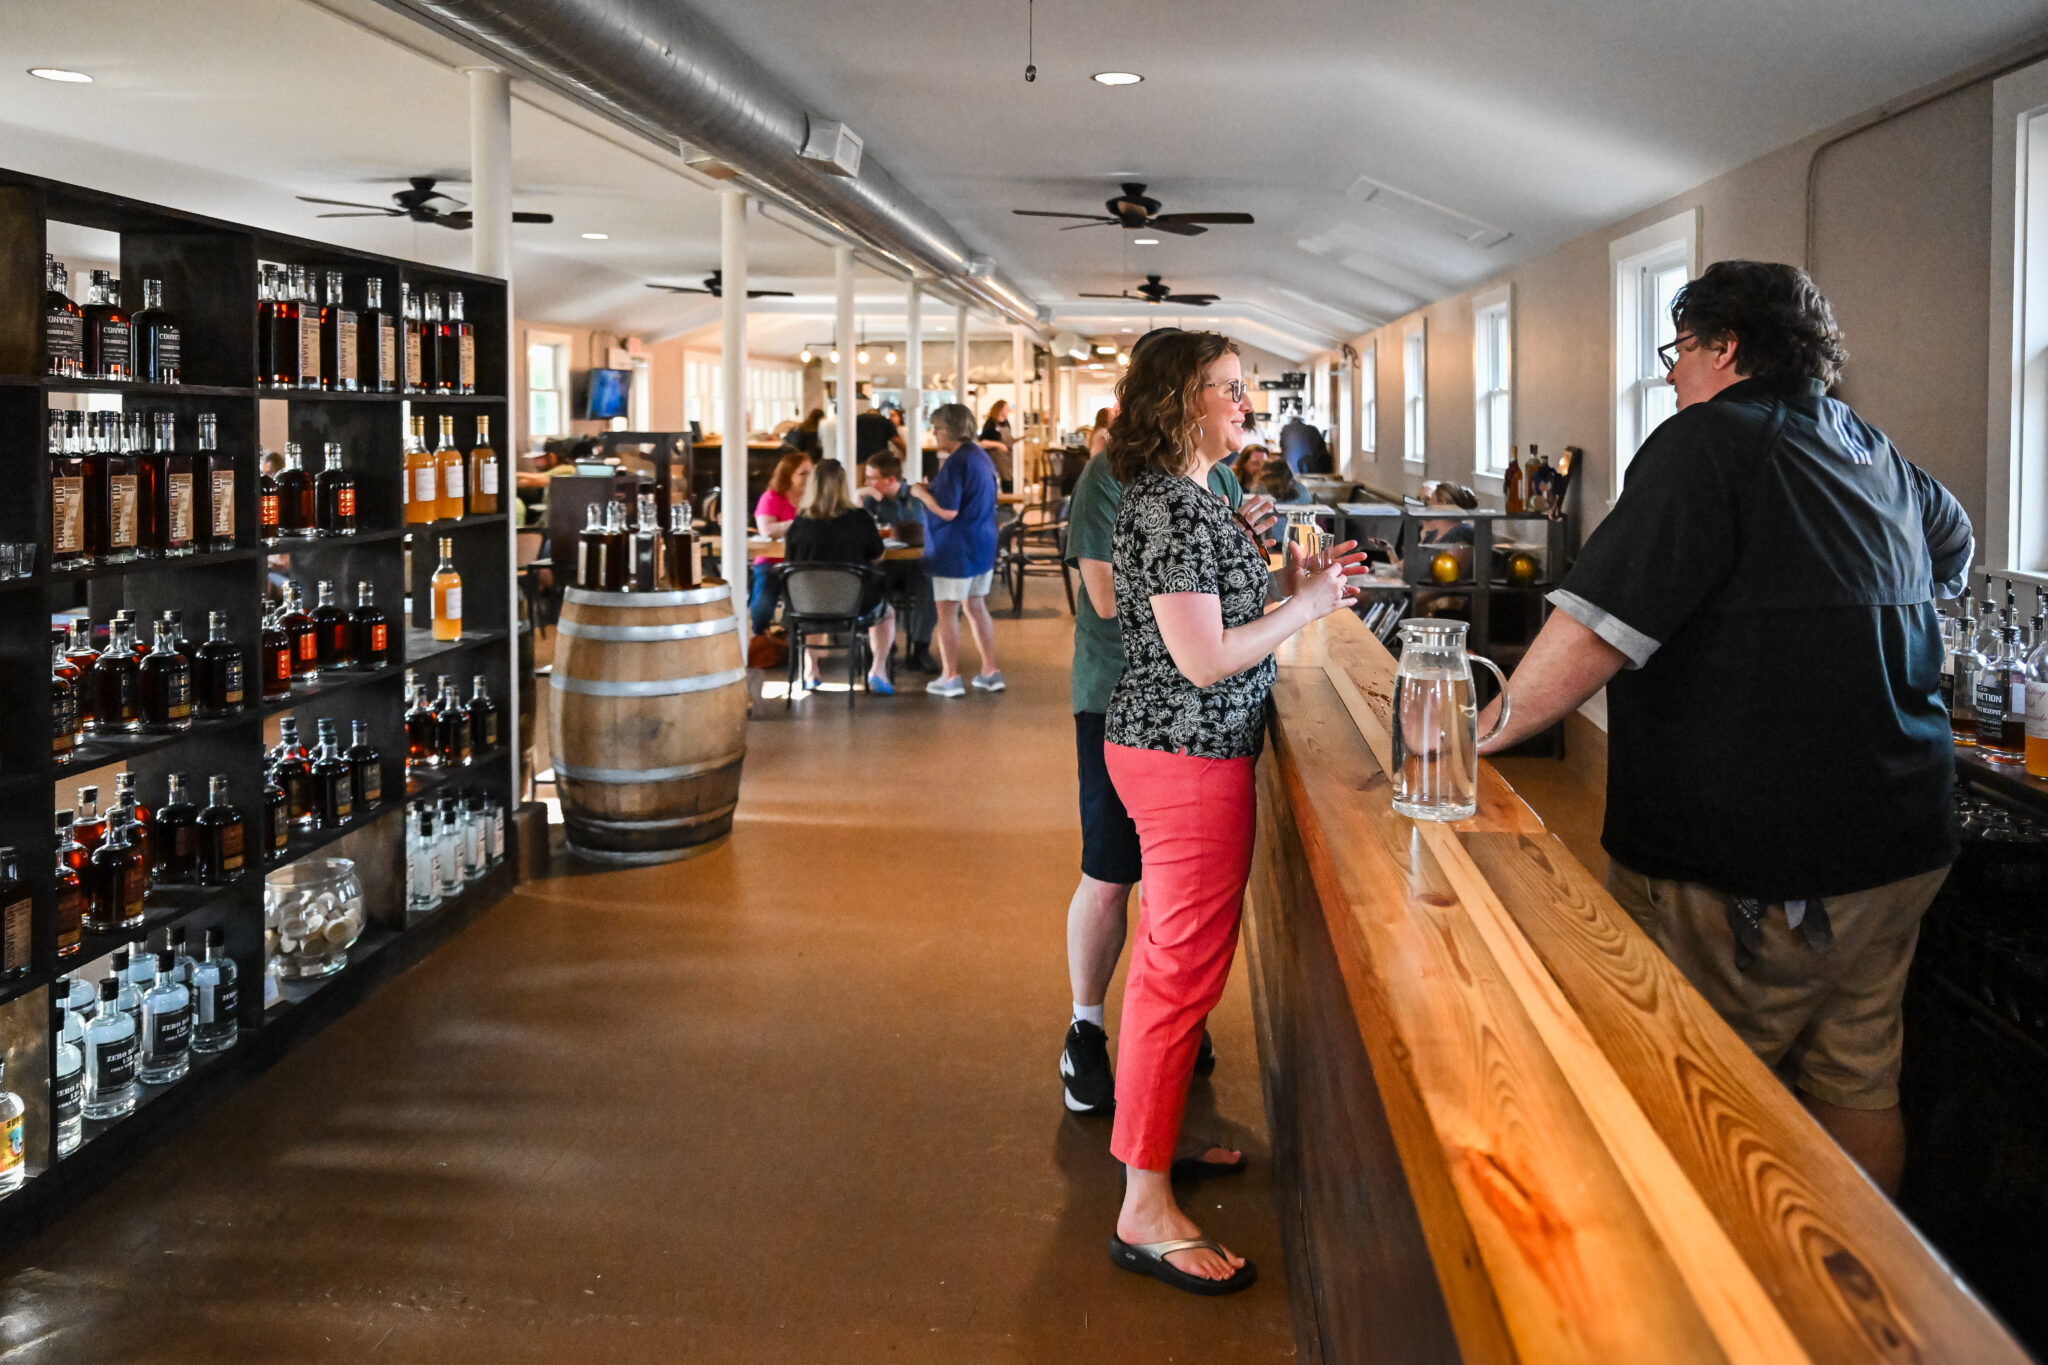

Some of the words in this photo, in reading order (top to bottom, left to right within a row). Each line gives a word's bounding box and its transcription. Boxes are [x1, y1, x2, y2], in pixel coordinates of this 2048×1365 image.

[55, 479, 65, 551] CONVICTION
[112, 477, 122, 545] CONVICTION
[161, 1021, 181, 1032] ZERO
[106, 1051, 127, 1063] ZERO
